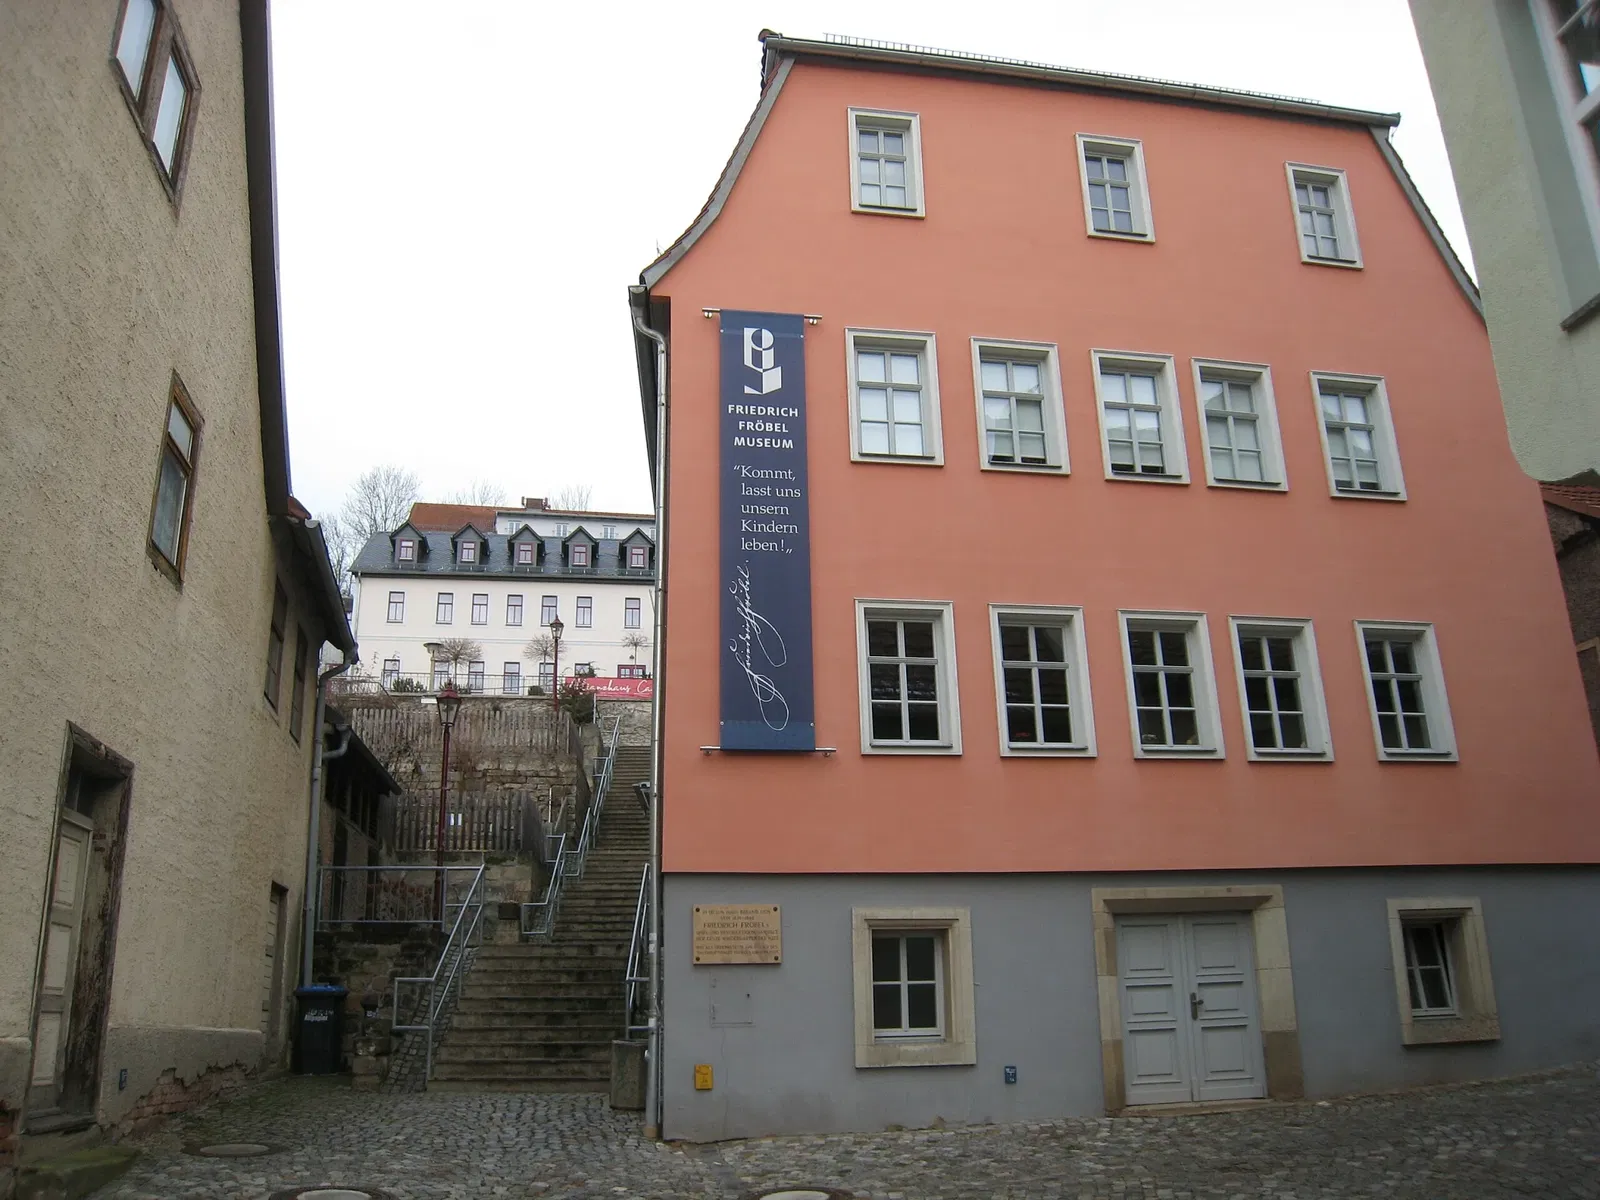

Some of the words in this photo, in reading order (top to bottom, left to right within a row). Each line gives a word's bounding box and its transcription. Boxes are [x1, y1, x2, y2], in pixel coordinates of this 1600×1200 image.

[728, 404, 798, 417] FRIEDRICH
[738, 420, 789, 433] FRÖBEL
[734, 436, 794, 449] MUSEUM
[741, 482, 772, 497] lasst
[775, 488, 801, 498] uns
[741, 504, 790, 515] unsern
[741, 519, 799, 534] Kindern
